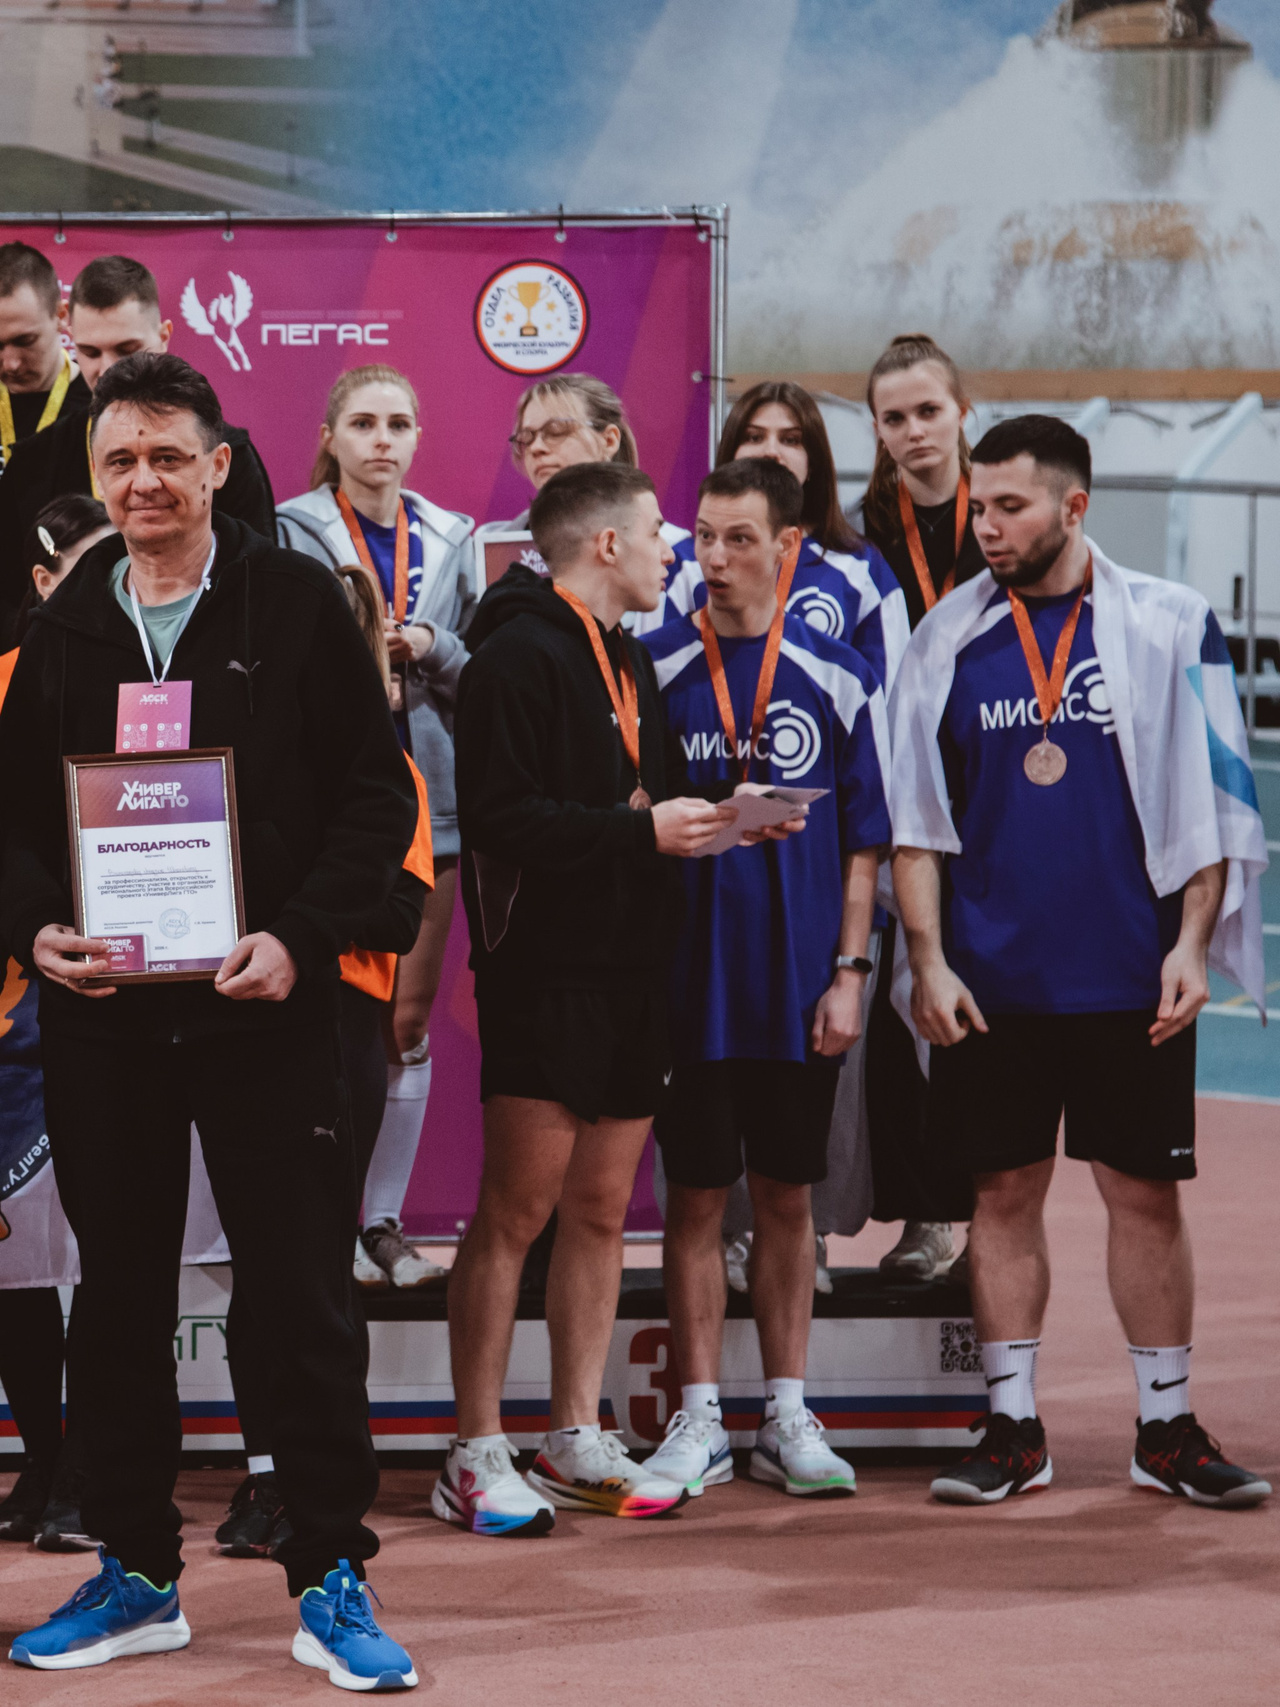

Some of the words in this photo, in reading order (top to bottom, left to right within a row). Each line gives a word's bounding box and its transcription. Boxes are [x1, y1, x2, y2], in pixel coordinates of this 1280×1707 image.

[261, 323, 389, 346] ПЕГАС
[122, 780, 182, 797] УНИВЕР
[97, 839, 211, 853] БЛАГОДАРНОСТЬ
[629, 1327, 682, 1442] 3
